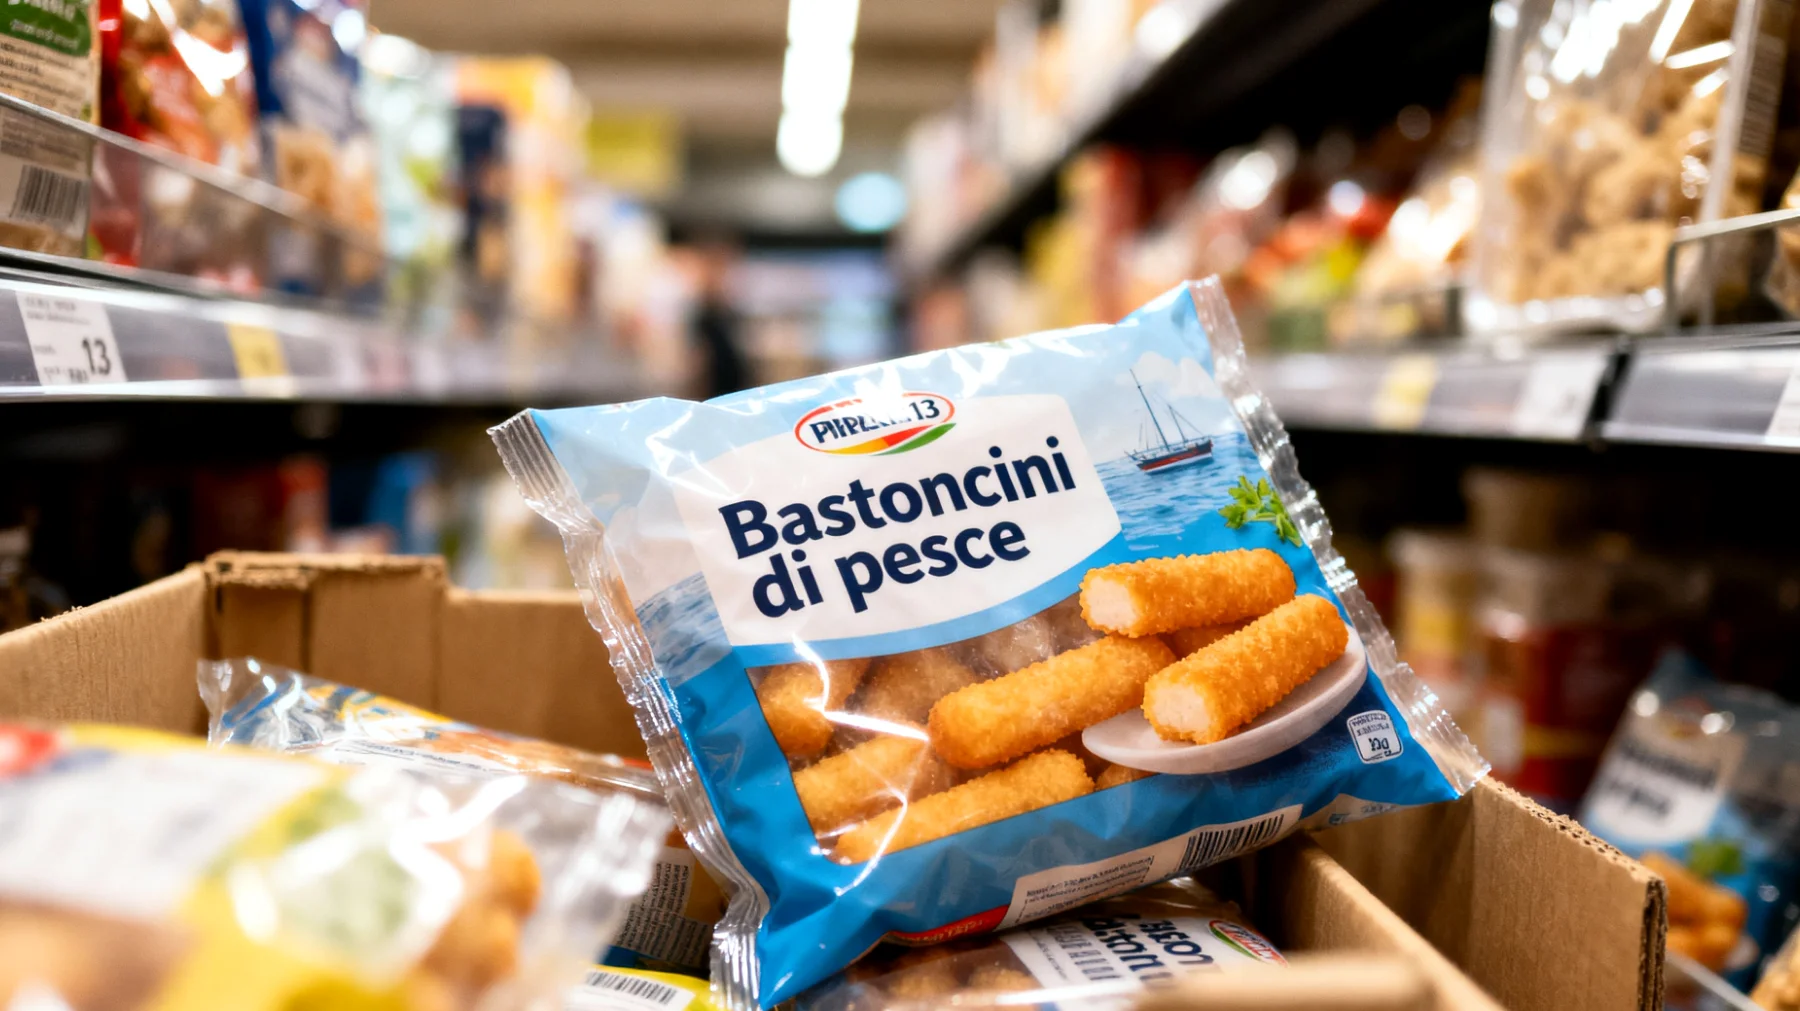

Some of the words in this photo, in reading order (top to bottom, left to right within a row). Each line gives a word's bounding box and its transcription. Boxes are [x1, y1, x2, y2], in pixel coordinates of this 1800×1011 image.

[82, 338, 111, 376] 13
[909, 399, 940, 421] 13
[718, 436, 1077, 560] Bastoncini
[752, 549, 824, 618] di
[834, 521, 1030, 613] pesce
